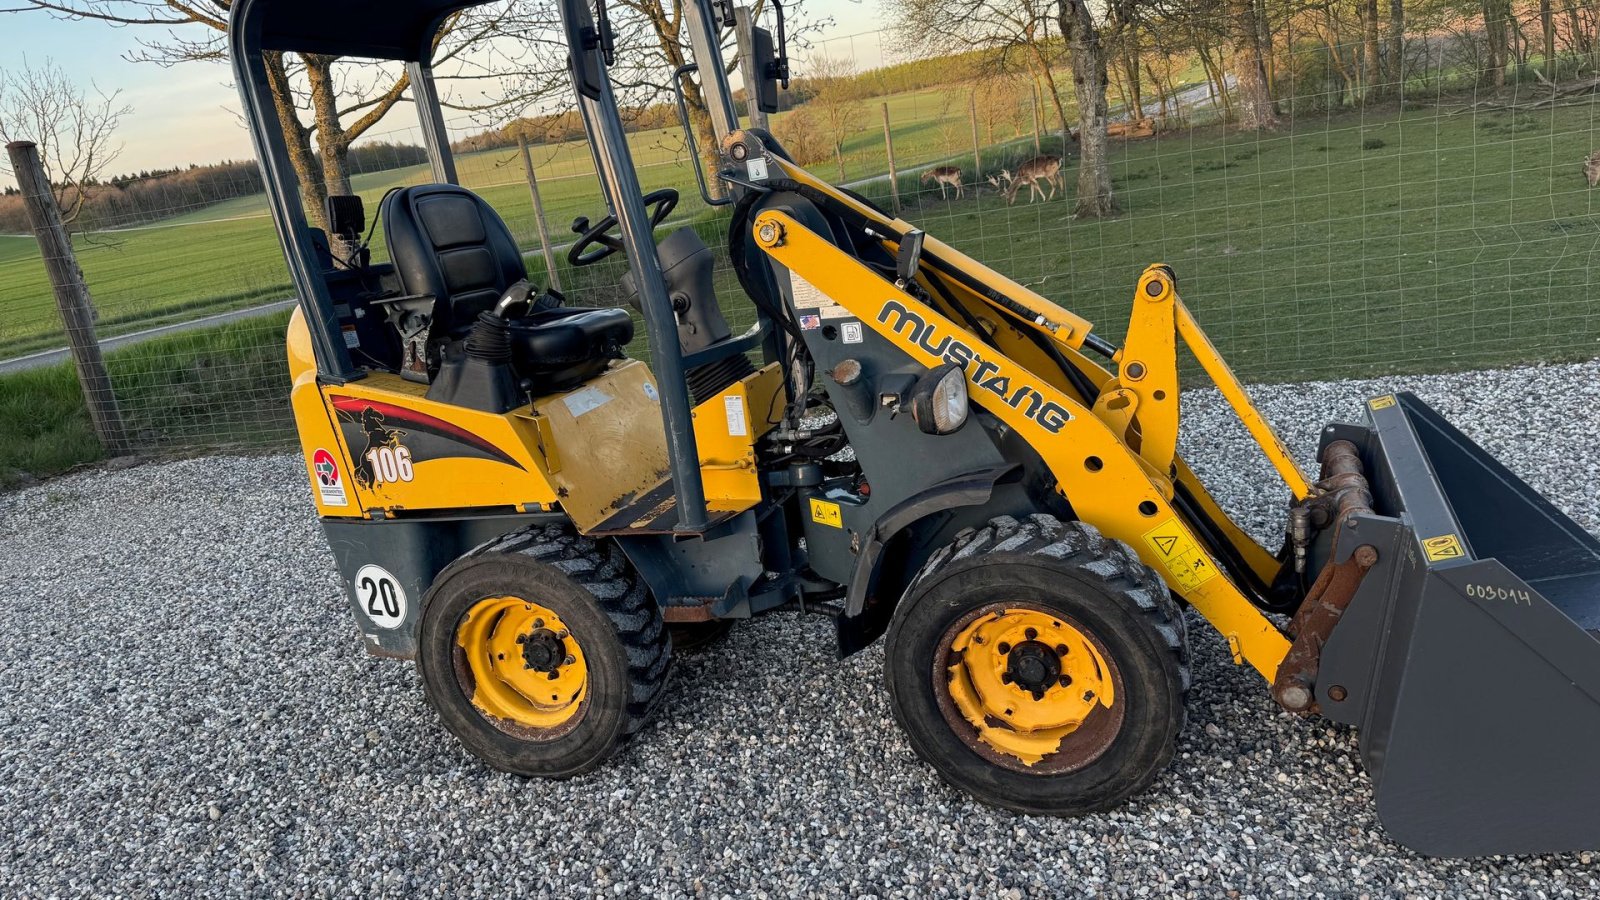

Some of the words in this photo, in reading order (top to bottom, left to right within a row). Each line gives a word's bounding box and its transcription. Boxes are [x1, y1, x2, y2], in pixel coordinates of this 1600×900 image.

[367, 446, 414, 483] 106
[361, 577, 400, 617] 20
[1466, 584, 1531, 606] 603014
